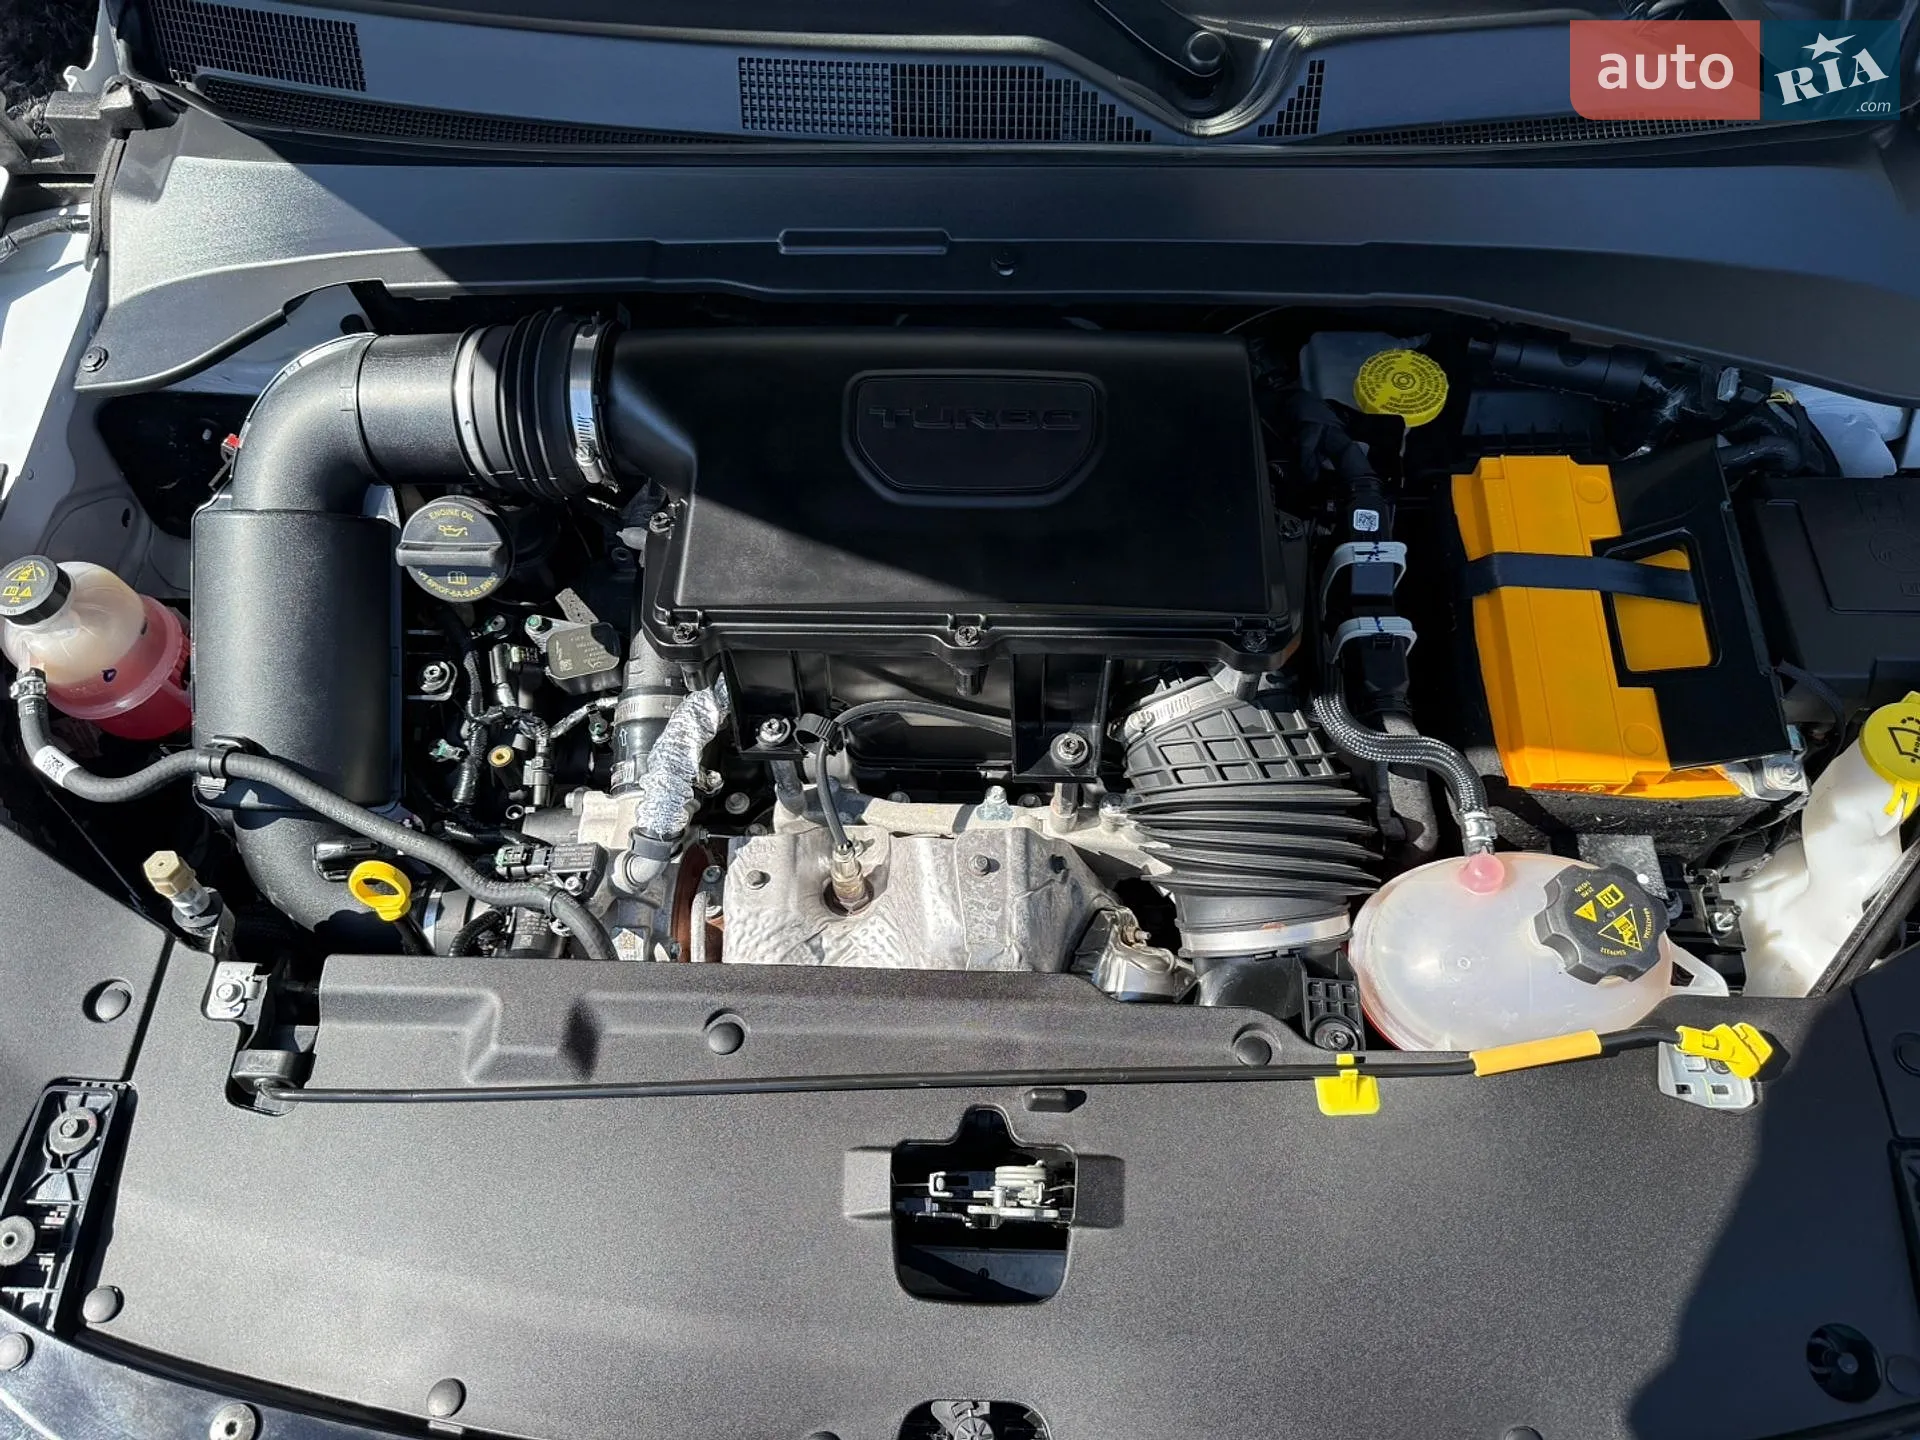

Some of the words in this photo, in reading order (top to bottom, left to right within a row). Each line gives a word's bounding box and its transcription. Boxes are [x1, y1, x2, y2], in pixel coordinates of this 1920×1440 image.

[868, 405, 1082, 431] TURBO
[428, 507, 460, 520] ENGINE
[461, 511, 475, 523] OIL
